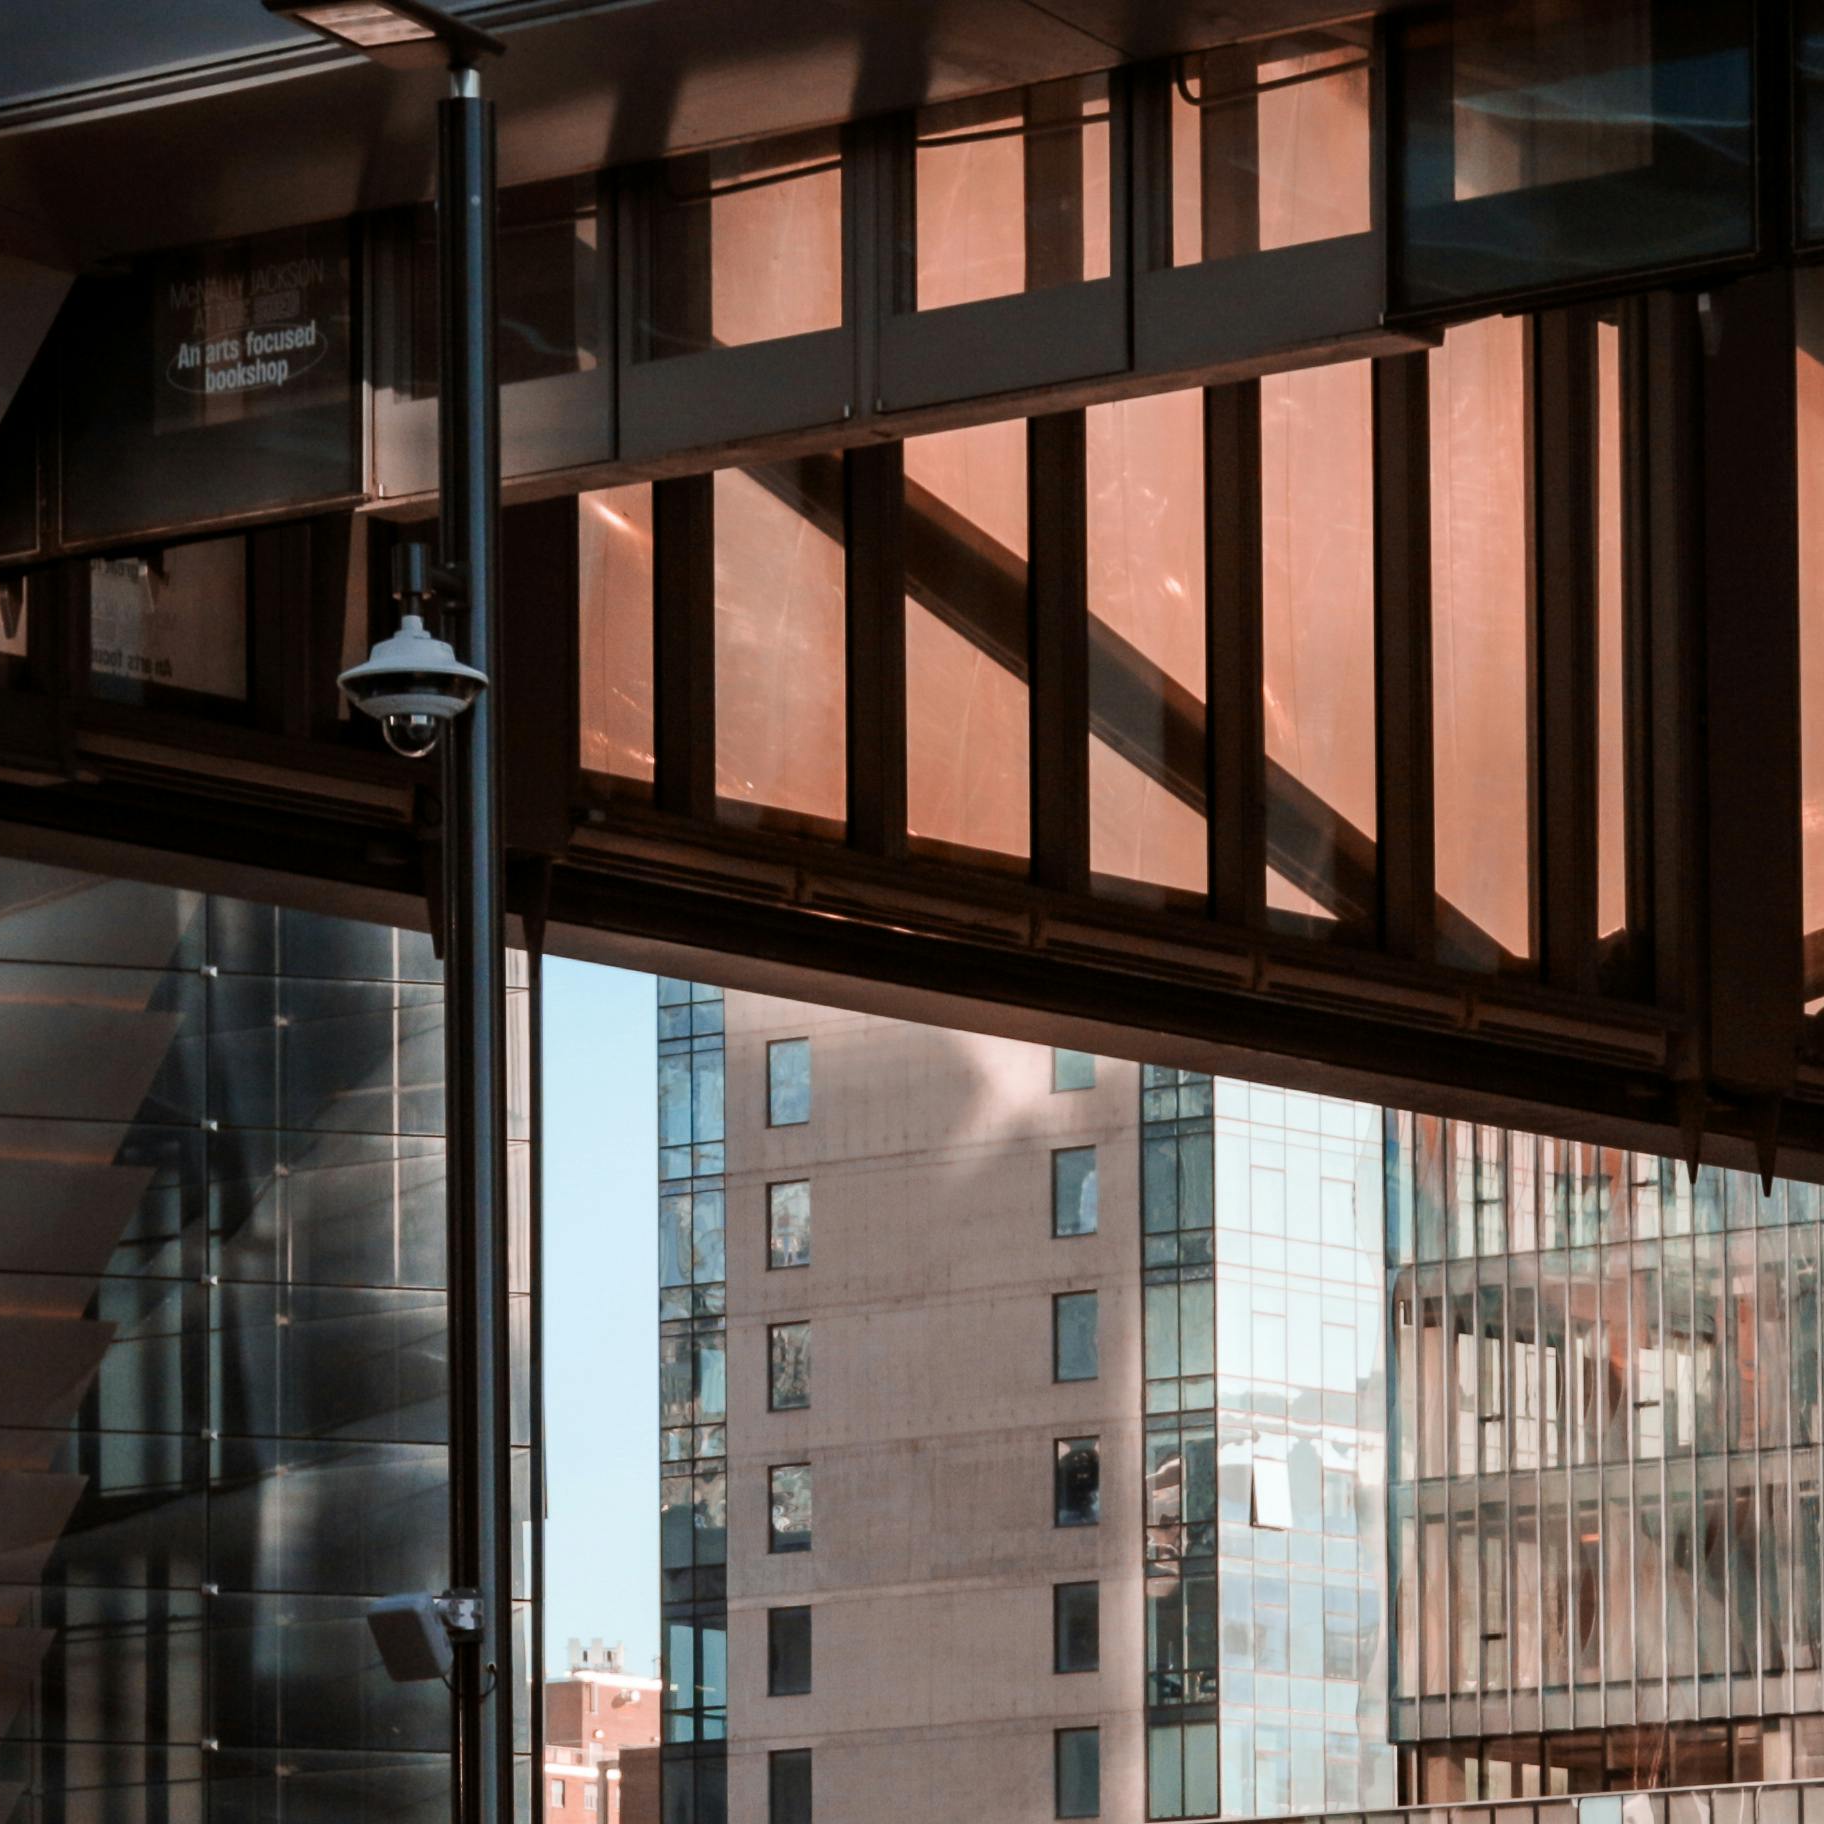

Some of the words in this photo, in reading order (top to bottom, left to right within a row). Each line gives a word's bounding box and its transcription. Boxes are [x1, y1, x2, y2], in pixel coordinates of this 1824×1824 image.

[178, 342, 201, 370] An
[205, 337, 240, 365] arts
[245, 319, 317, 357] focused
[205, 358, 289, 394] bookshop
